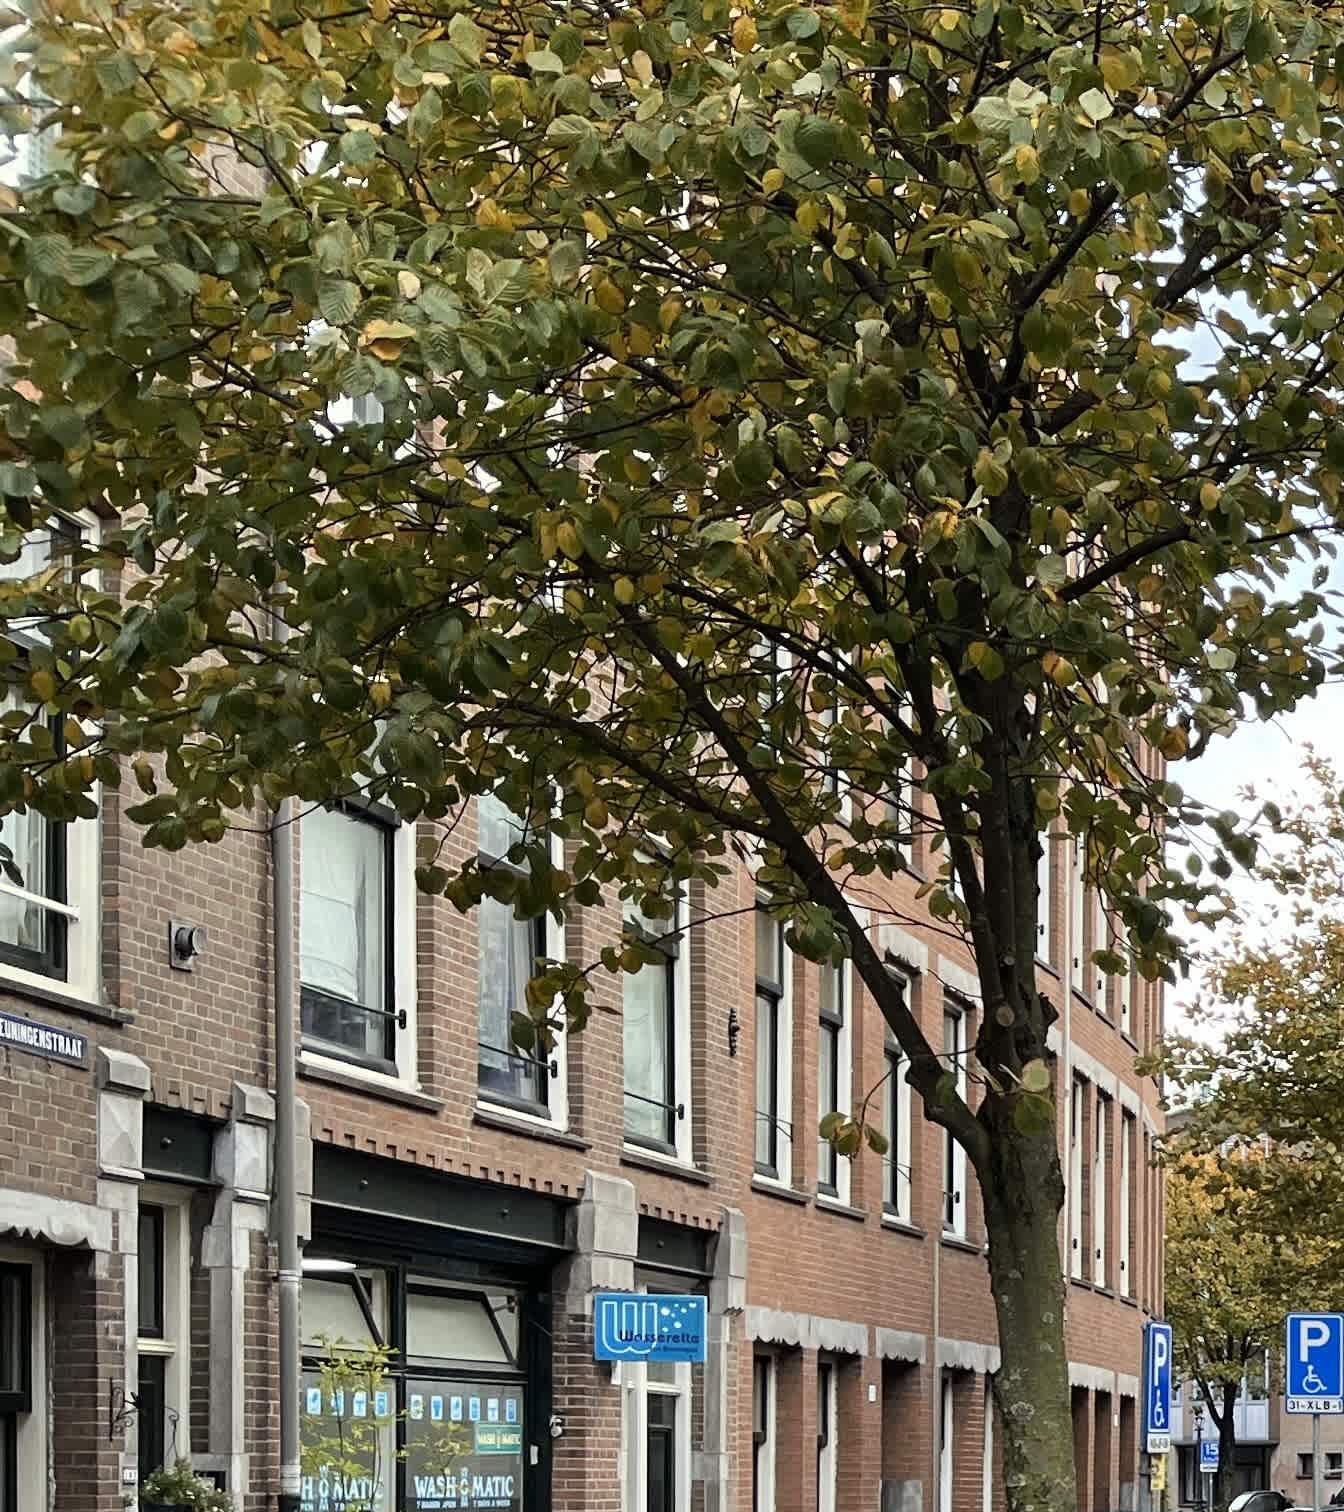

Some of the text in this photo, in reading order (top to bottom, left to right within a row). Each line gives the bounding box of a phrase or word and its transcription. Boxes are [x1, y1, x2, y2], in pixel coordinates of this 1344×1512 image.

[1154, 1332, 1167, 1387] P
[1299, 1320, 1331, 1362] P
[414, 1475, 457, 1498] WASH
[471, 1475, 514, 1498] MATIC
